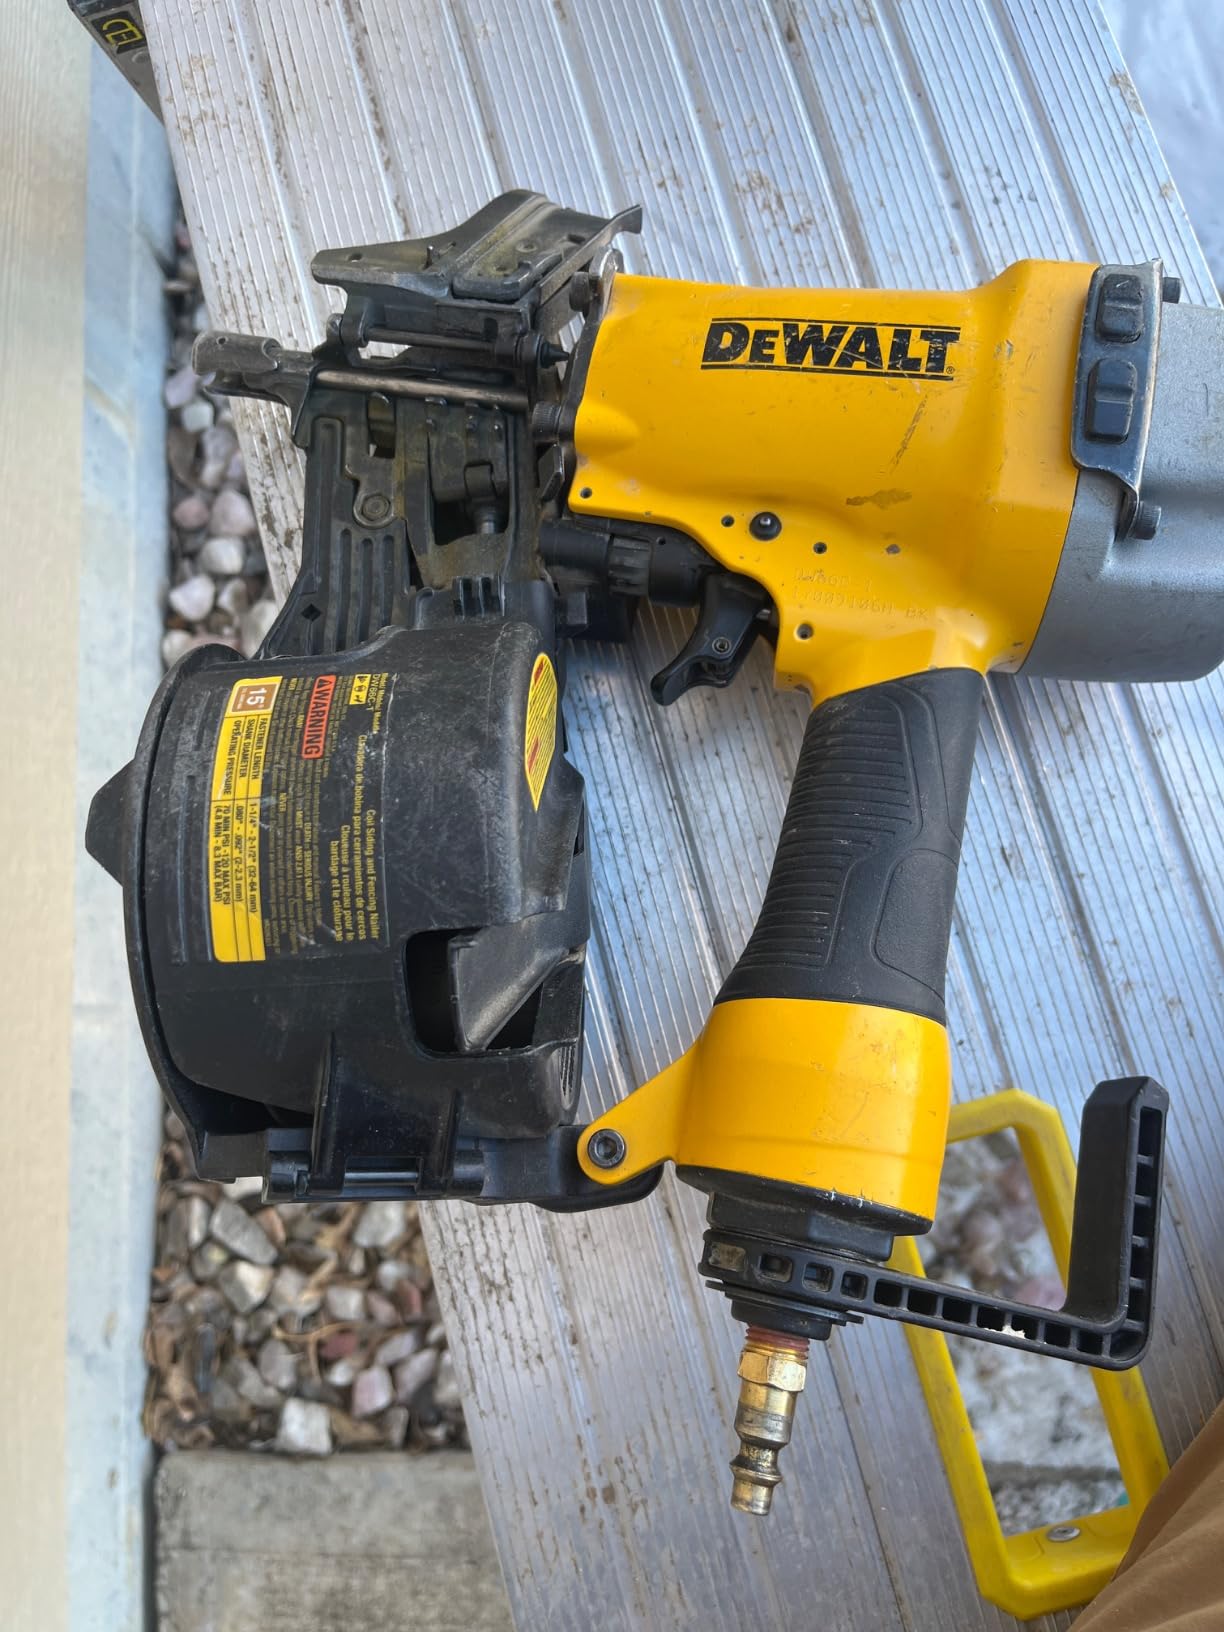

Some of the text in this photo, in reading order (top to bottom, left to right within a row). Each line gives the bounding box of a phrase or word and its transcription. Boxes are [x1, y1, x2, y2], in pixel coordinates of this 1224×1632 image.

[228, 720, 242, 756] OPERATING
[304, 689, 330, 755] WARNING
[239, 719, 255, 778] SHANK DIAMETER
[252, 718, 268, 780] FASTENER LENGTH
[223, 758, 235, 795] PRESSURE
[223, 805, 230, 814] 70
[341, 825, 351, 864] Cloueuse
[352, 735, 368, 940] Clavadora de bobina para cerramientos de cercos
[214, 861, 222, 879] MAX
[329, 841, 340, 876] bardage
[365, 809, 380, 939] Coil Siding and Fencing Nailer
[214, 882, 222, 902] BAR)
[223, 892, 231, 904] PSI
[235, 883, 243, 902] mm)
[332, 879, 340, 887] et
[342, 875, 352, 908] rouleau
[249, 894, 257, 913] mm)
[343, 911, 353, 930] pour
[346, 932, 355, 940] le
